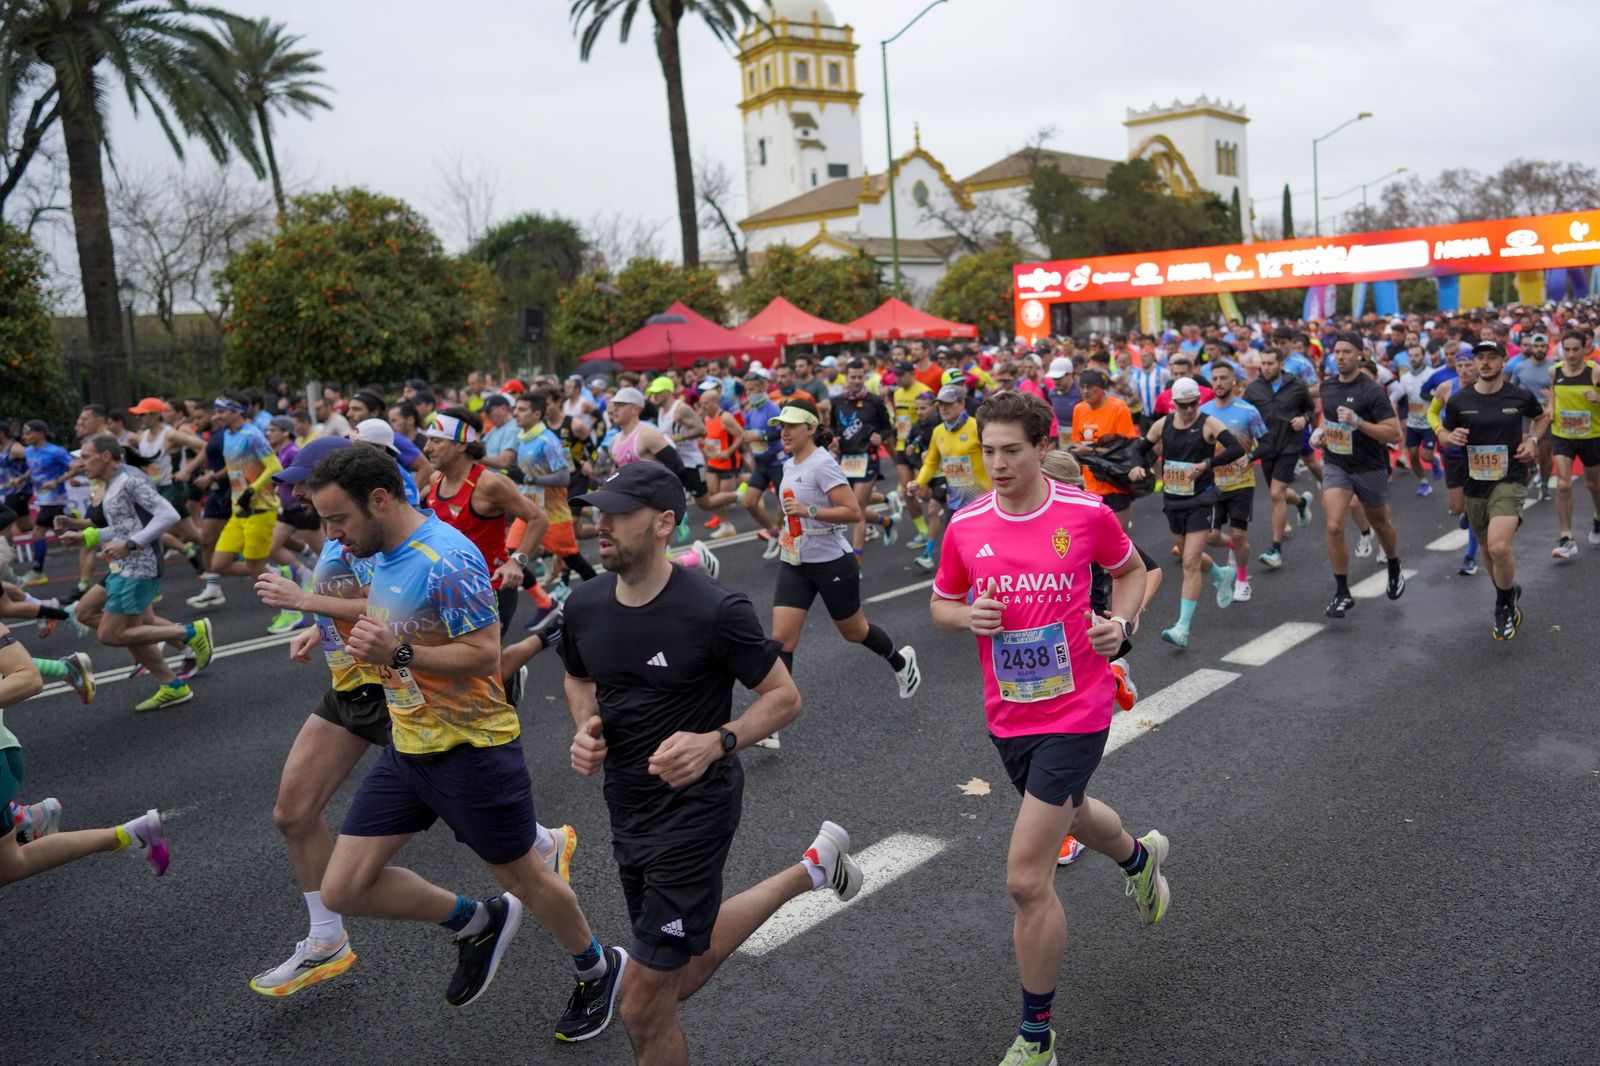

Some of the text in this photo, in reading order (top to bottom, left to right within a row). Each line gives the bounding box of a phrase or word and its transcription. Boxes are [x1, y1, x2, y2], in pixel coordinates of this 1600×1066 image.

[1474, 454, 1498, 466] 5115
[1166, 469, 1185, 481] 5118
[976, 573, 1075, 595] CARAVAN
[992, 593, 1071, 604] AGANCIAS
[1001, 645, 1050, 670] 2438
[661, 925, 685, 938] adidas
